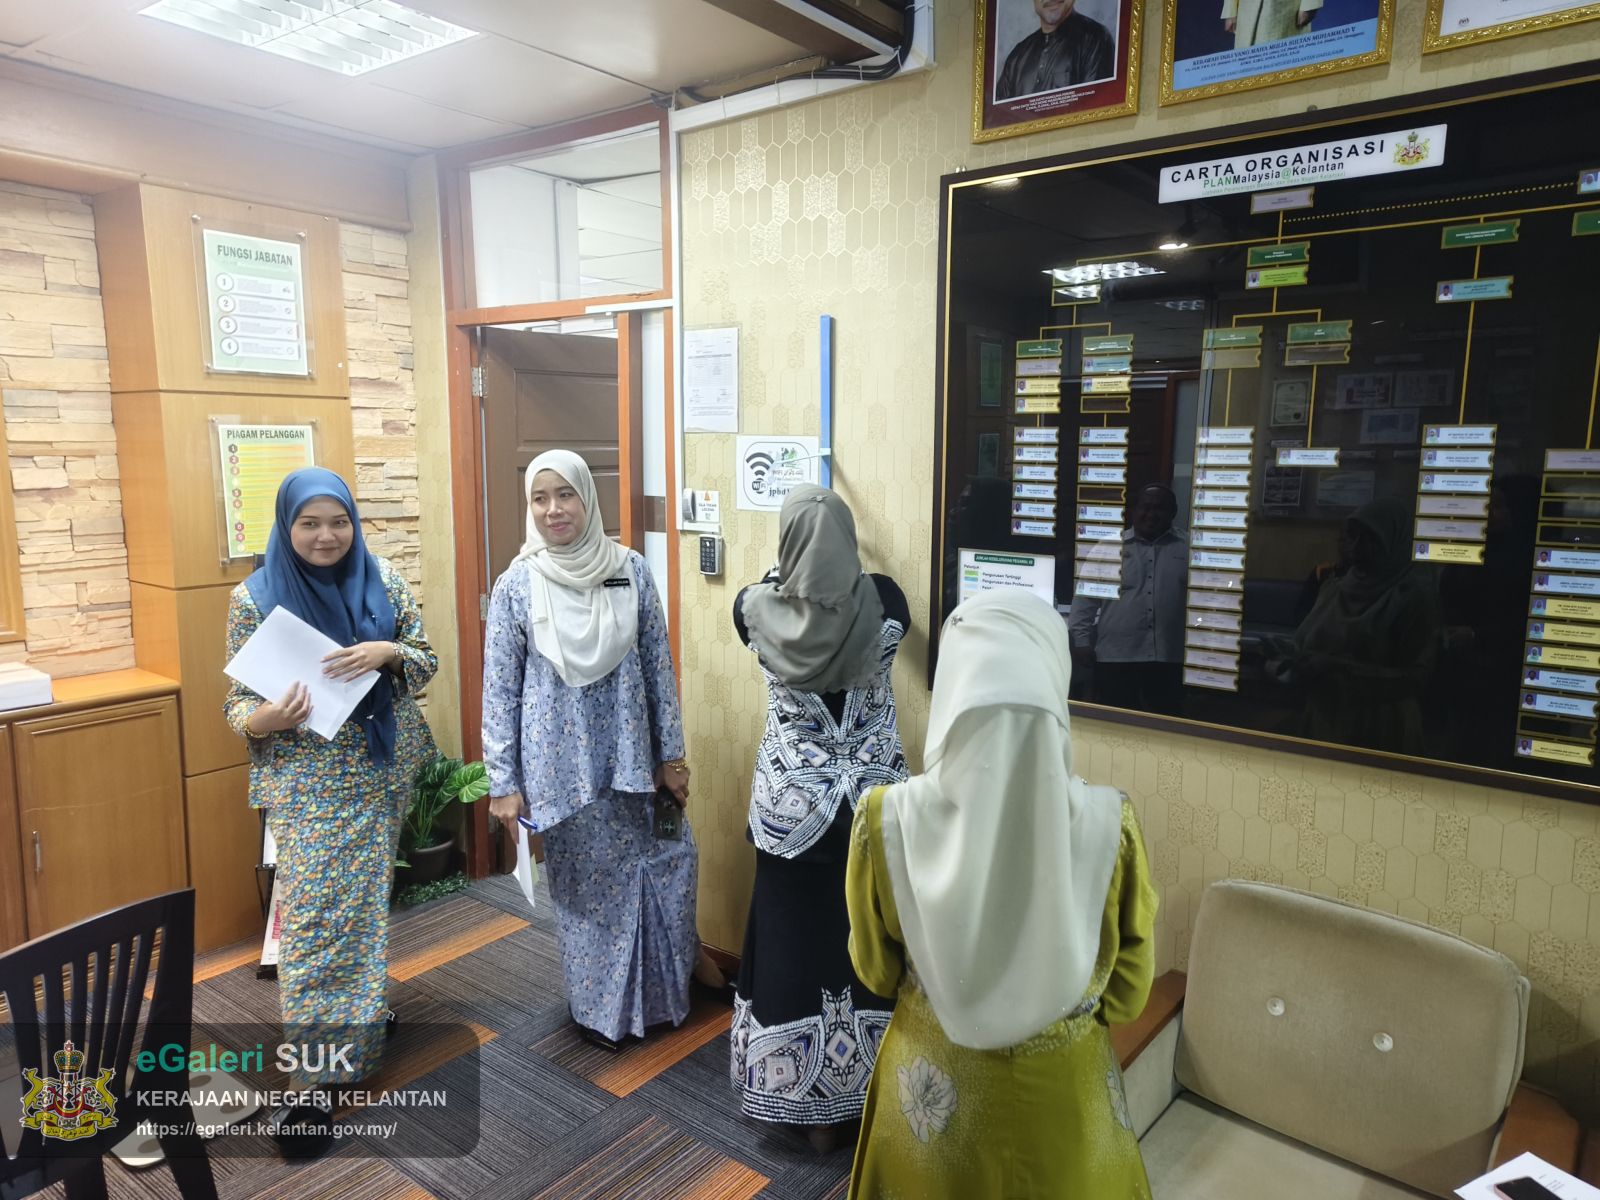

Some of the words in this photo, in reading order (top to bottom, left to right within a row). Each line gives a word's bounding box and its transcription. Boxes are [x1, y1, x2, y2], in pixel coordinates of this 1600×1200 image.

[1171, 162, 1235, 183] CARTA
[1245, 139, 1385, 173] ORGANISASI
[217, 245, 252, 259] FUNGSI
[254, 251, 293, 266] JABATAN
[227, 429, 258, 439] PIAGAM
[259, 430, 305, 439] PELANGGAN
